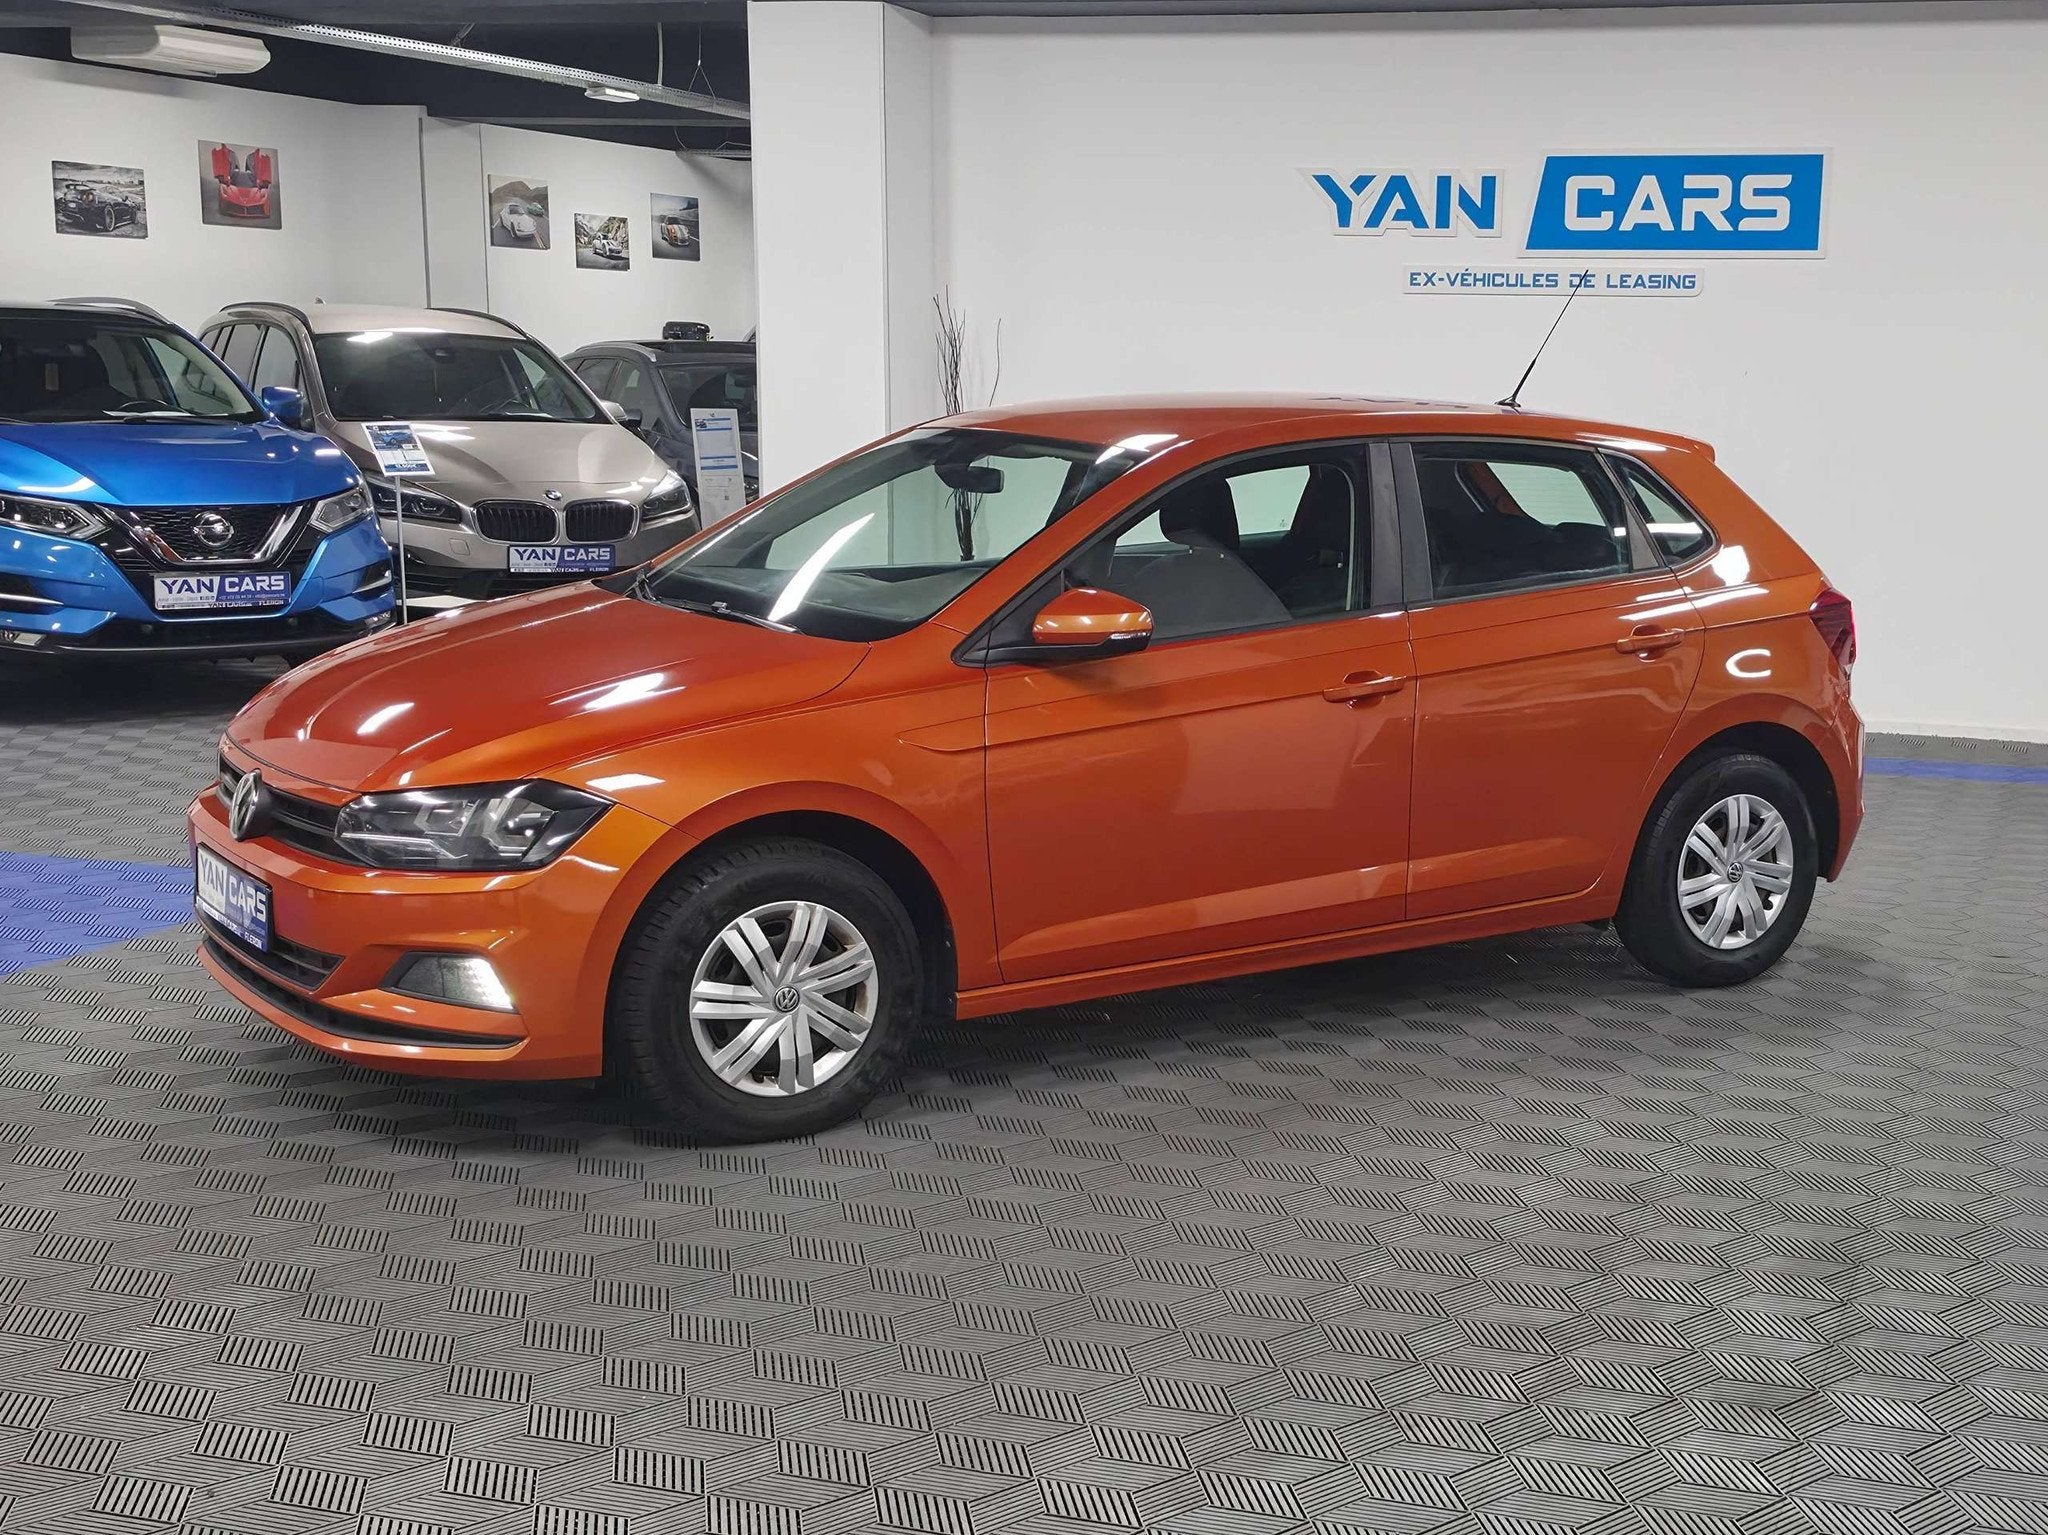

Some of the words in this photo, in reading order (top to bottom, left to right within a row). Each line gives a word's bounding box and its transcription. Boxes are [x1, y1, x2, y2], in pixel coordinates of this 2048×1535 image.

[1311, 174, 1498, 229] YAN
[1564, 174, 1793, 232] CARS
[1408, 268, 1559, 289] EX-VÉHICULES
[1569, 272, 1596, 289] DE
[1606, 273, 1697, 291] LEASING
[513, 548, 556, 561] YAN
[564, 547, 611, 561] CARS
[160, 578, 214, 594] YAN
[225, 575, 284, 592] CARS
[200, 853, 225, 898] YAN
[229, 874, 267, 923] CARS
